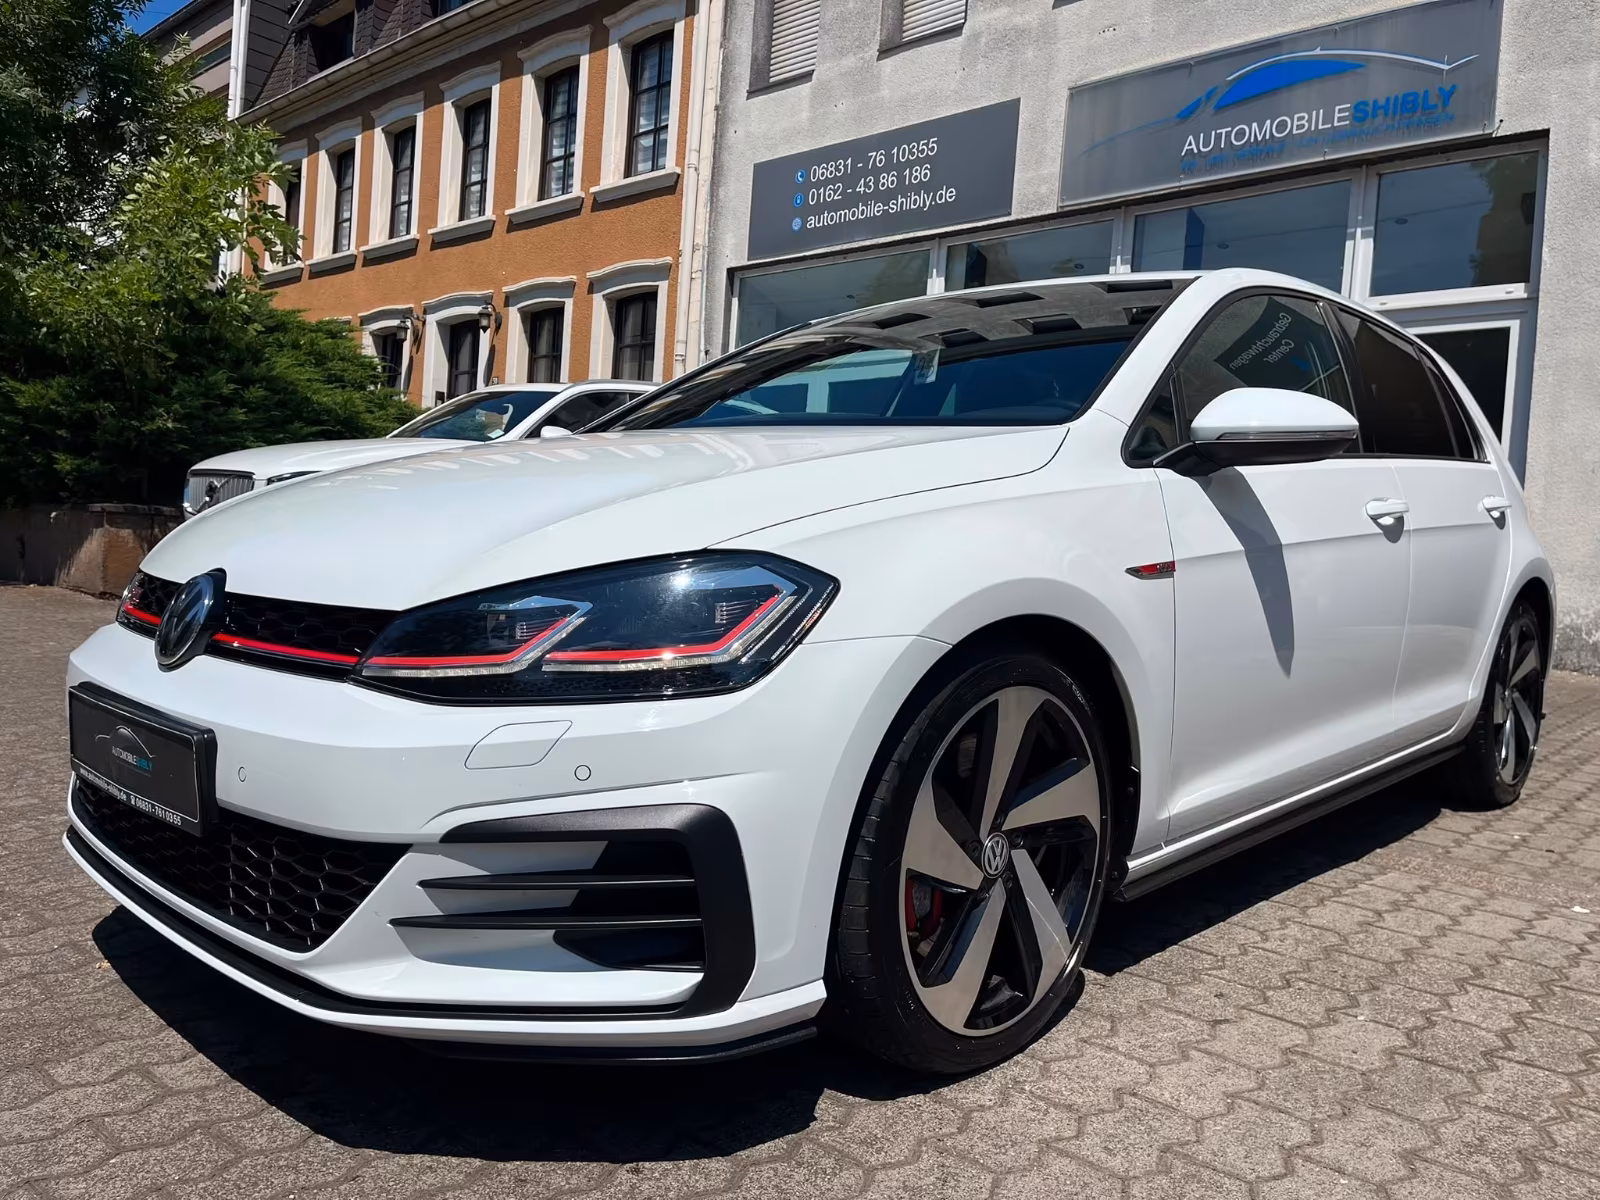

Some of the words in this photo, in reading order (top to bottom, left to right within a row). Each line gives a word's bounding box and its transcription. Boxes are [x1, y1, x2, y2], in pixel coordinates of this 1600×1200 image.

[810, 157, 852, 182] 06831
[867, 150, 885, 170] 76
[891, 137, 938, 164] 10355
[808, 183, 842, 205] 0162
[856, 176, 874, 195] 43
[879, 171, 897, 190] 86
[903, 164, 931, 186] 186
[806, 185, 956, 229] automobile-shibly.de
